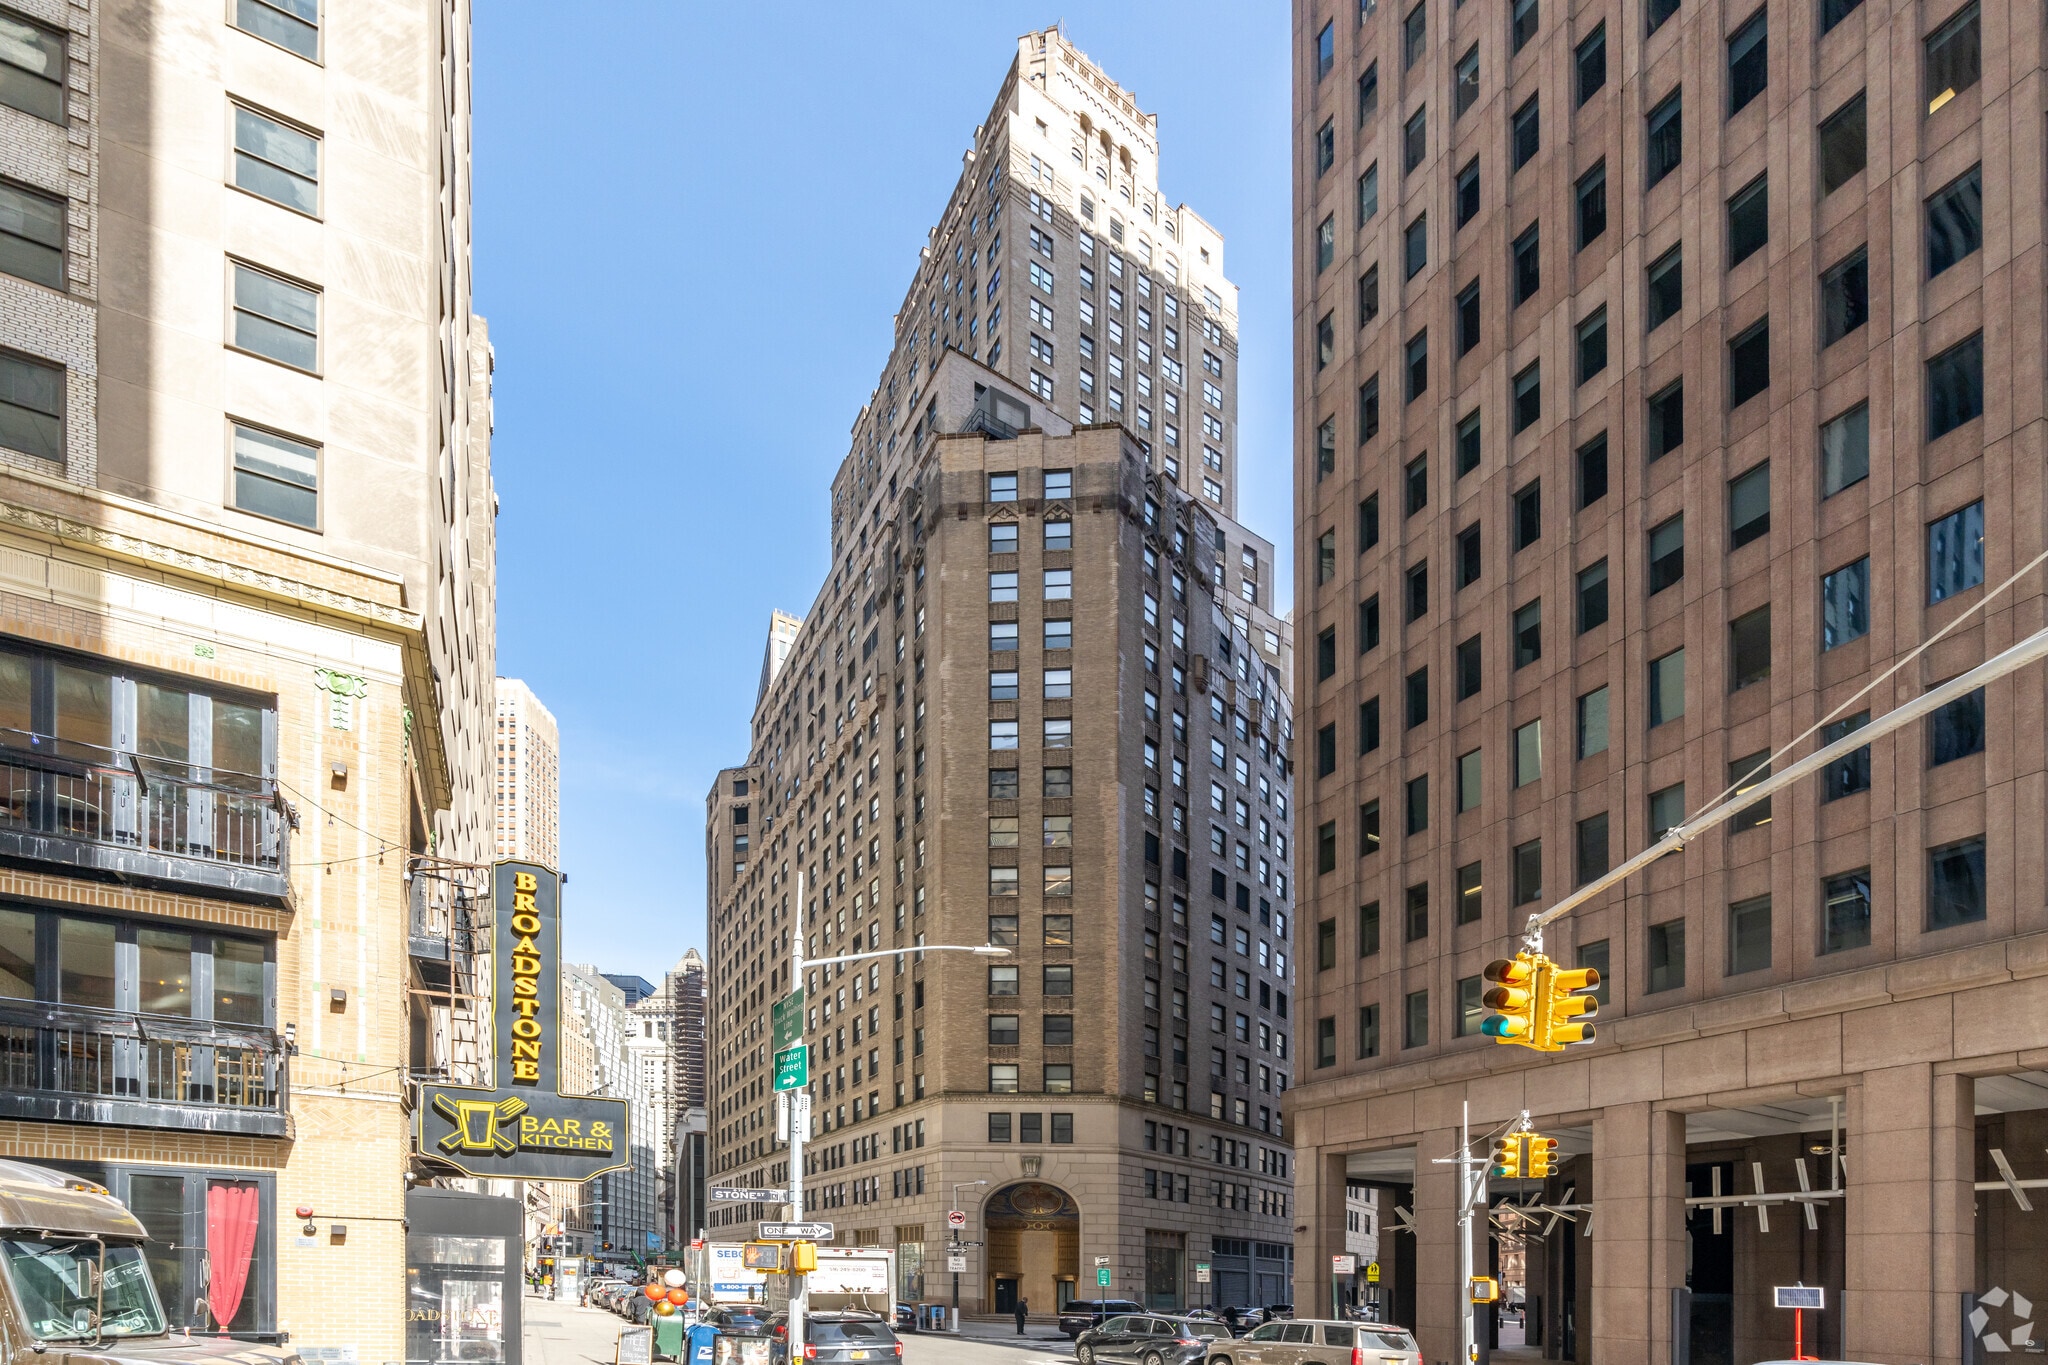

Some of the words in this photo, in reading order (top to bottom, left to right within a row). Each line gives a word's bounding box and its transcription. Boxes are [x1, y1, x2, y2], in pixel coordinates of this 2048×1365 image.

[512, 871, 542, 1081] BROADSTONE
[784, 998, 794, 1009] NYSE
[784, 1020, 793, 1030] Line
[780, 1051, 801, 1063] Water
[780, 1061, 801, 1073] Street
[521, 1116, 581, 1135] BAR
[590, 1121, 612, 1138] &
[521, 1132, 613, 1150] KITCHEN
[715, 1190, 757, 1200] STONE
[623, 1334, 647, 1347] FREE
